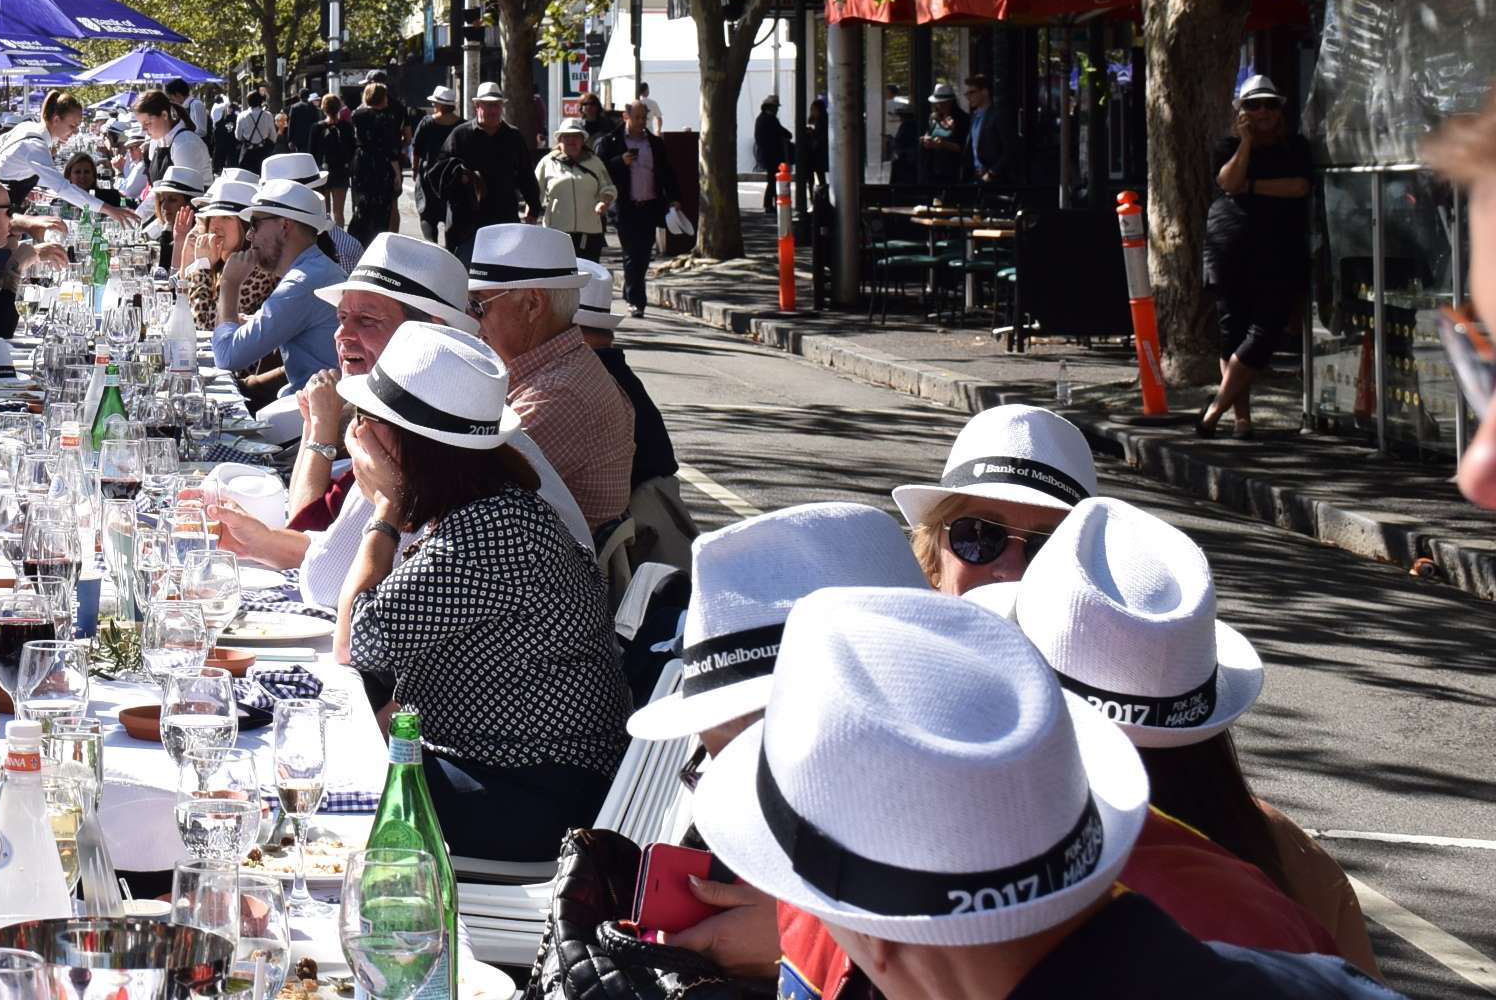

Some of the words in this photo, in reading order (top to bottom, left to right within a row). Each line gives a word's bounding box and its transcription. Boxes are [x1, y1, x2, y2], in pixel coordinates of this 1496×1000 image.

[571, 72, 589, 80] ELEV
[469, 424, 497, 435] 2017
[985, 463, 1016, 474] Bank
[1016, 467, 1030, 477] of
[701, 655, 713, 673] of
[713, 643, 782, 669] Melbour
[1087, 695, 1151, 726] 2017
[6, 757, 26, 768] NNA
[947, 874, 1040, 915] 2017
